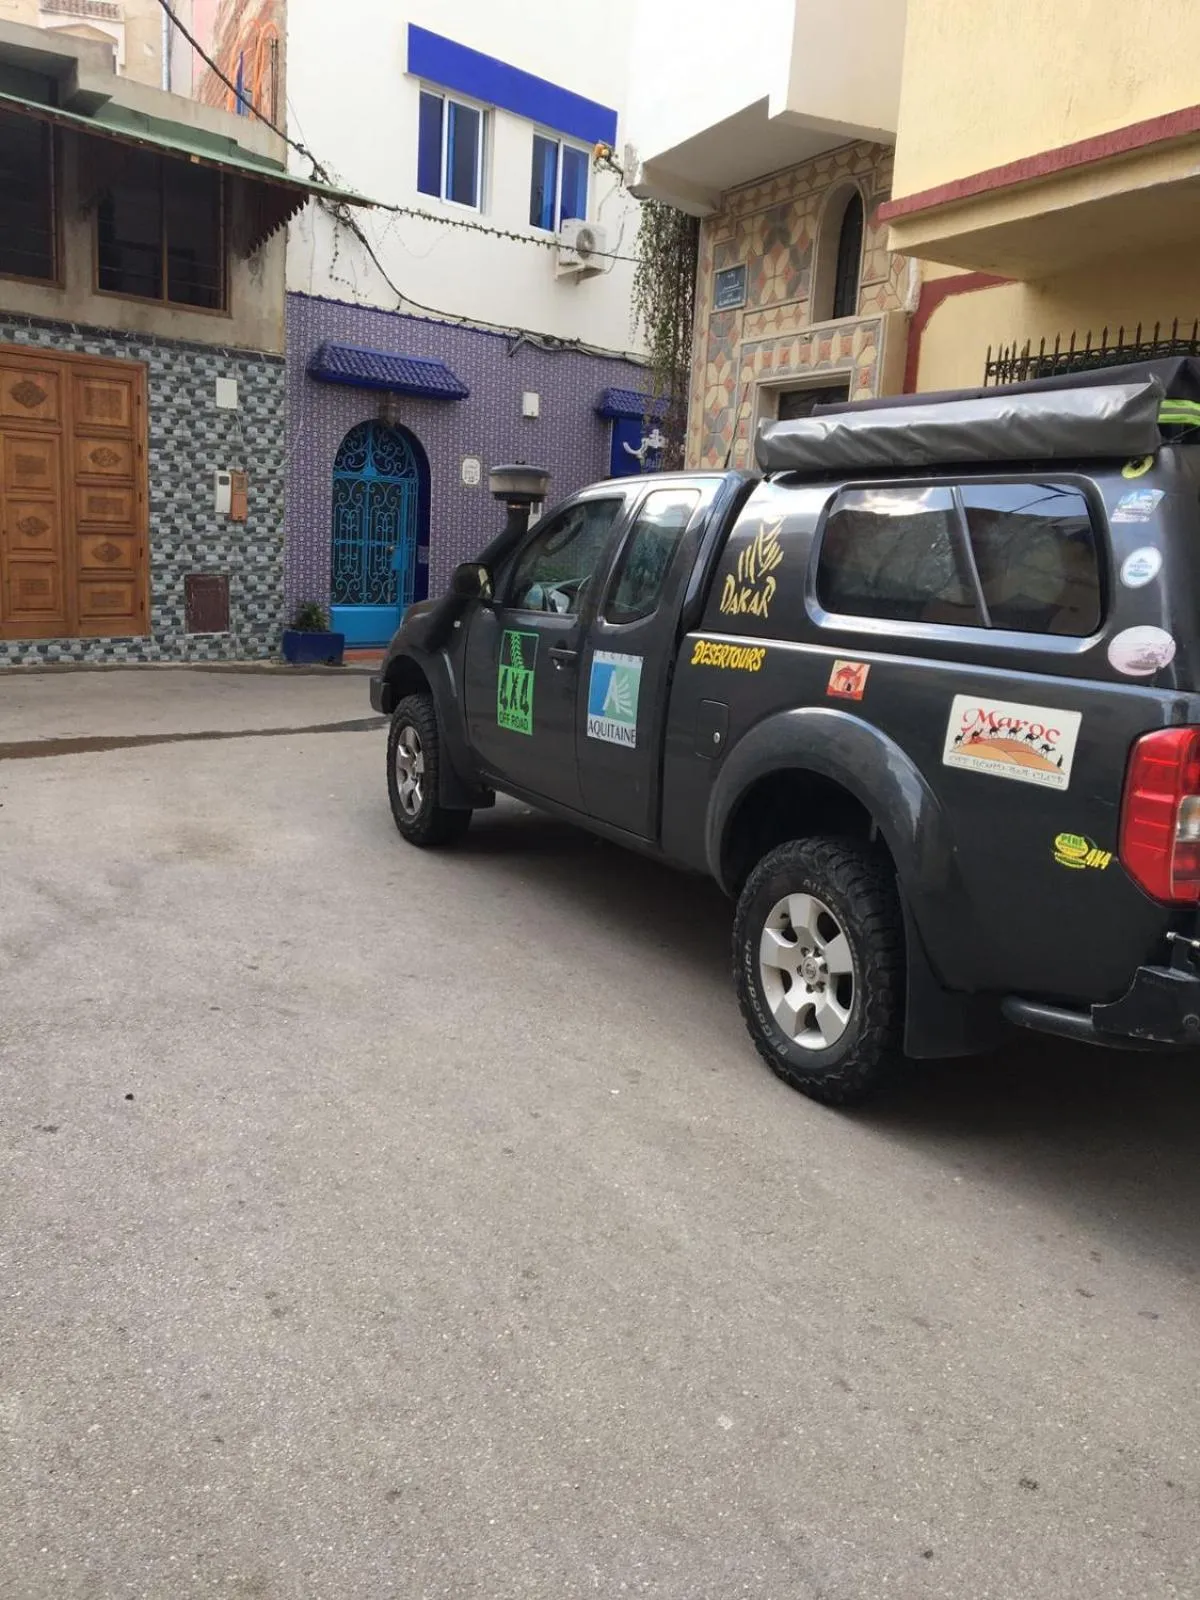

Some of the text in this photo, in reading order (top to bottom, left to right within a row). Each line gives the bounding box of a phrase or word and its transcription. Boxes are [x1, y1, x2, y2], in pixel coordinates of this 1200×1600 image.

[720, 574, 776, 618] DAKAR
[691, 640, 766, 672] DESERTOURS
[588, 719, 637, 744] AQUITAINE
[961, 708, 1061, 744] Maroc
